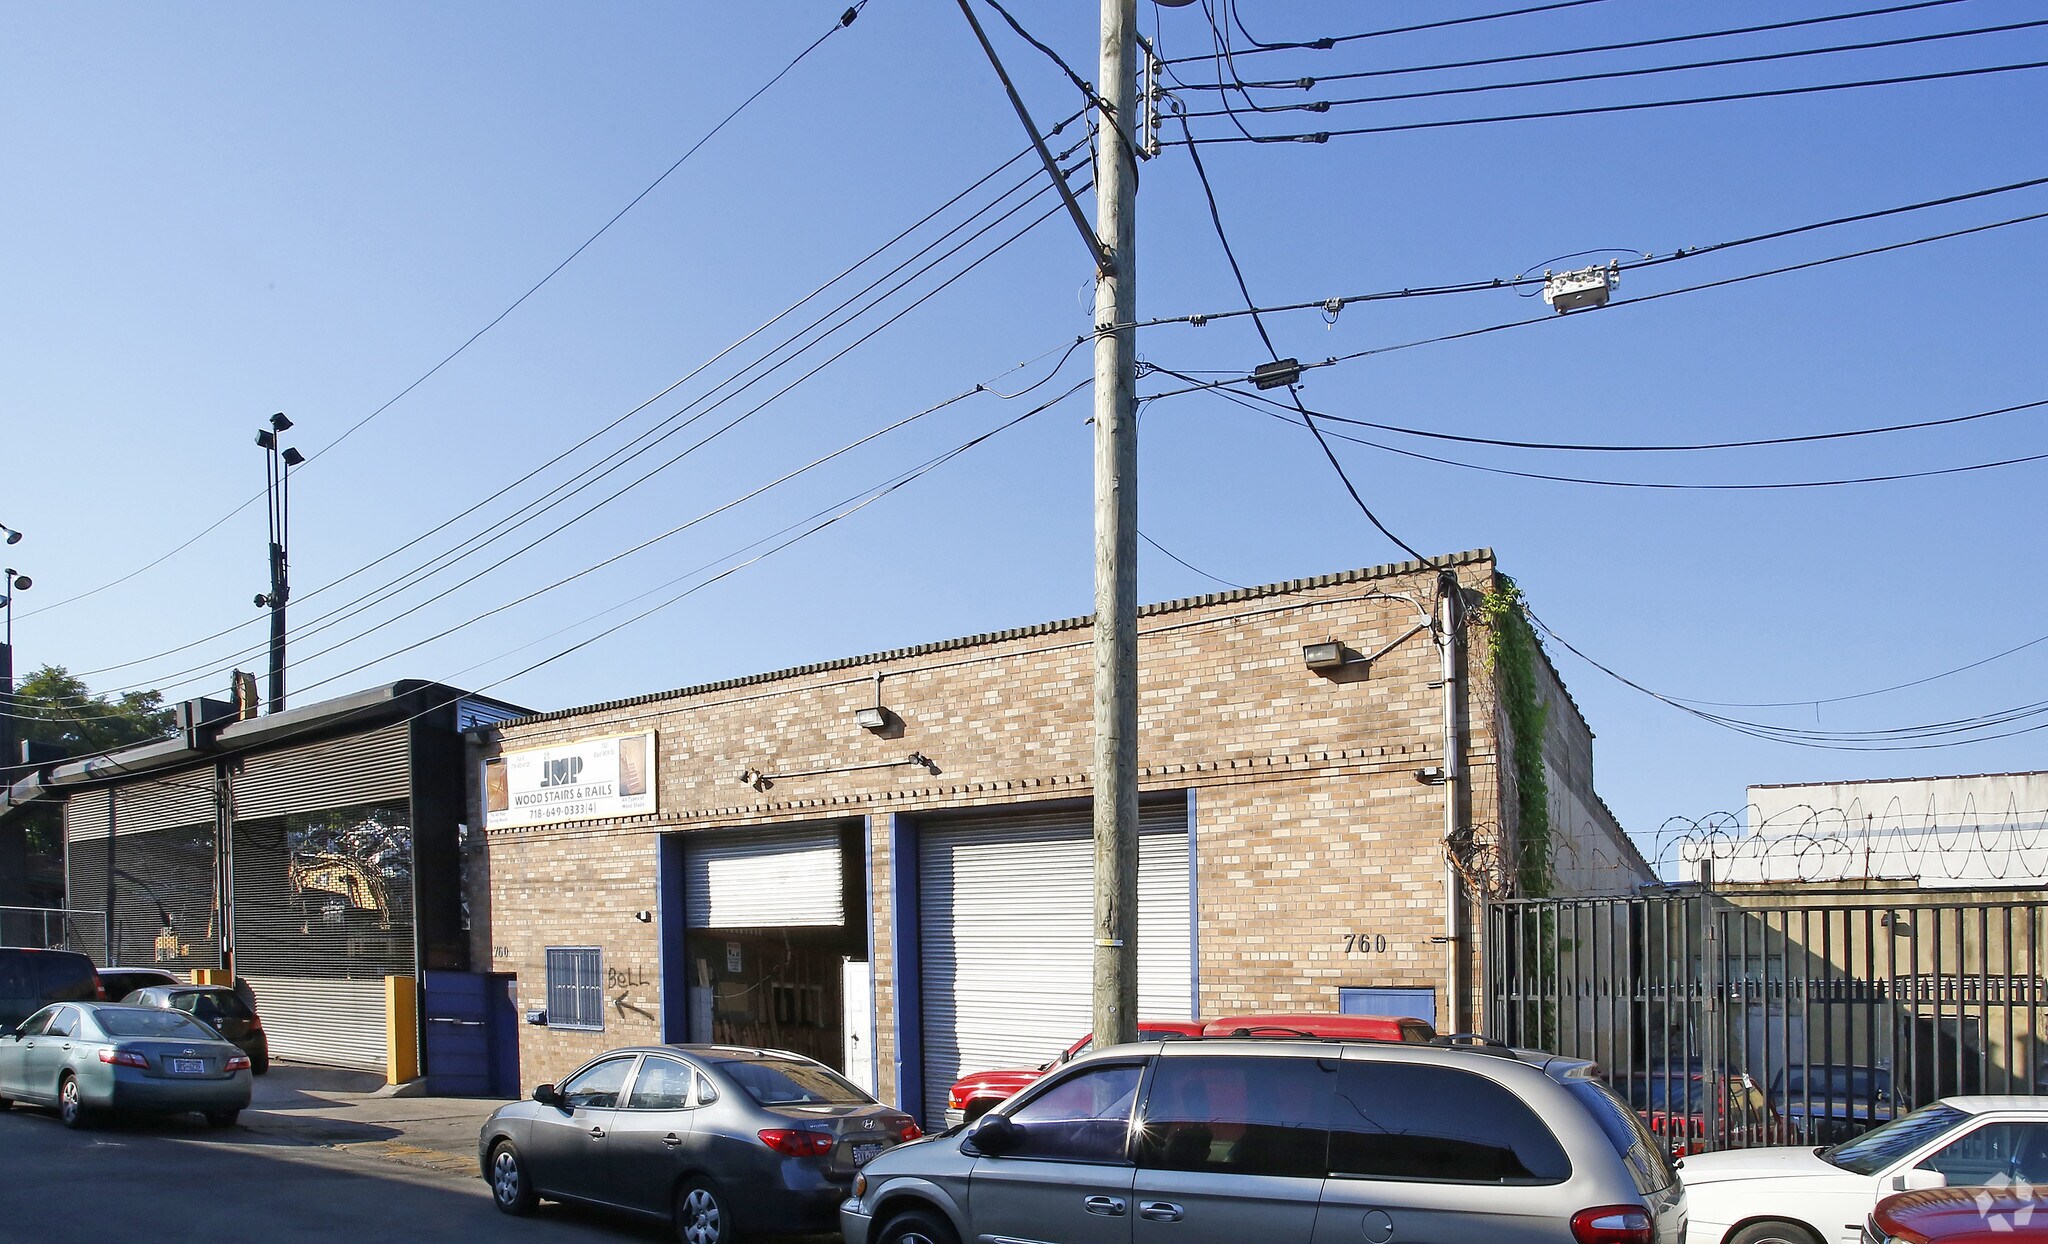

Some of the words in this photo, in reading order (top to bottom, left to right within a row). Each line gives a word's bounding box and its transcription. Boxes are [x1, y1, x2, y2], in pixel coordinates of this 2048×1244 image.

[540, 756, 583, 787] JMP
[515, 793, 542, 805] WOOD
[544, 789, 575, 803] STAIRS
[576, 788, 582, 798] &
[585, 784, 612, 798] RAILS
[530, 802, 596, 819] 718-649-0333(4)
[493, 946, 509, 958] 760
[1343, 934, 1386, 953] 760
